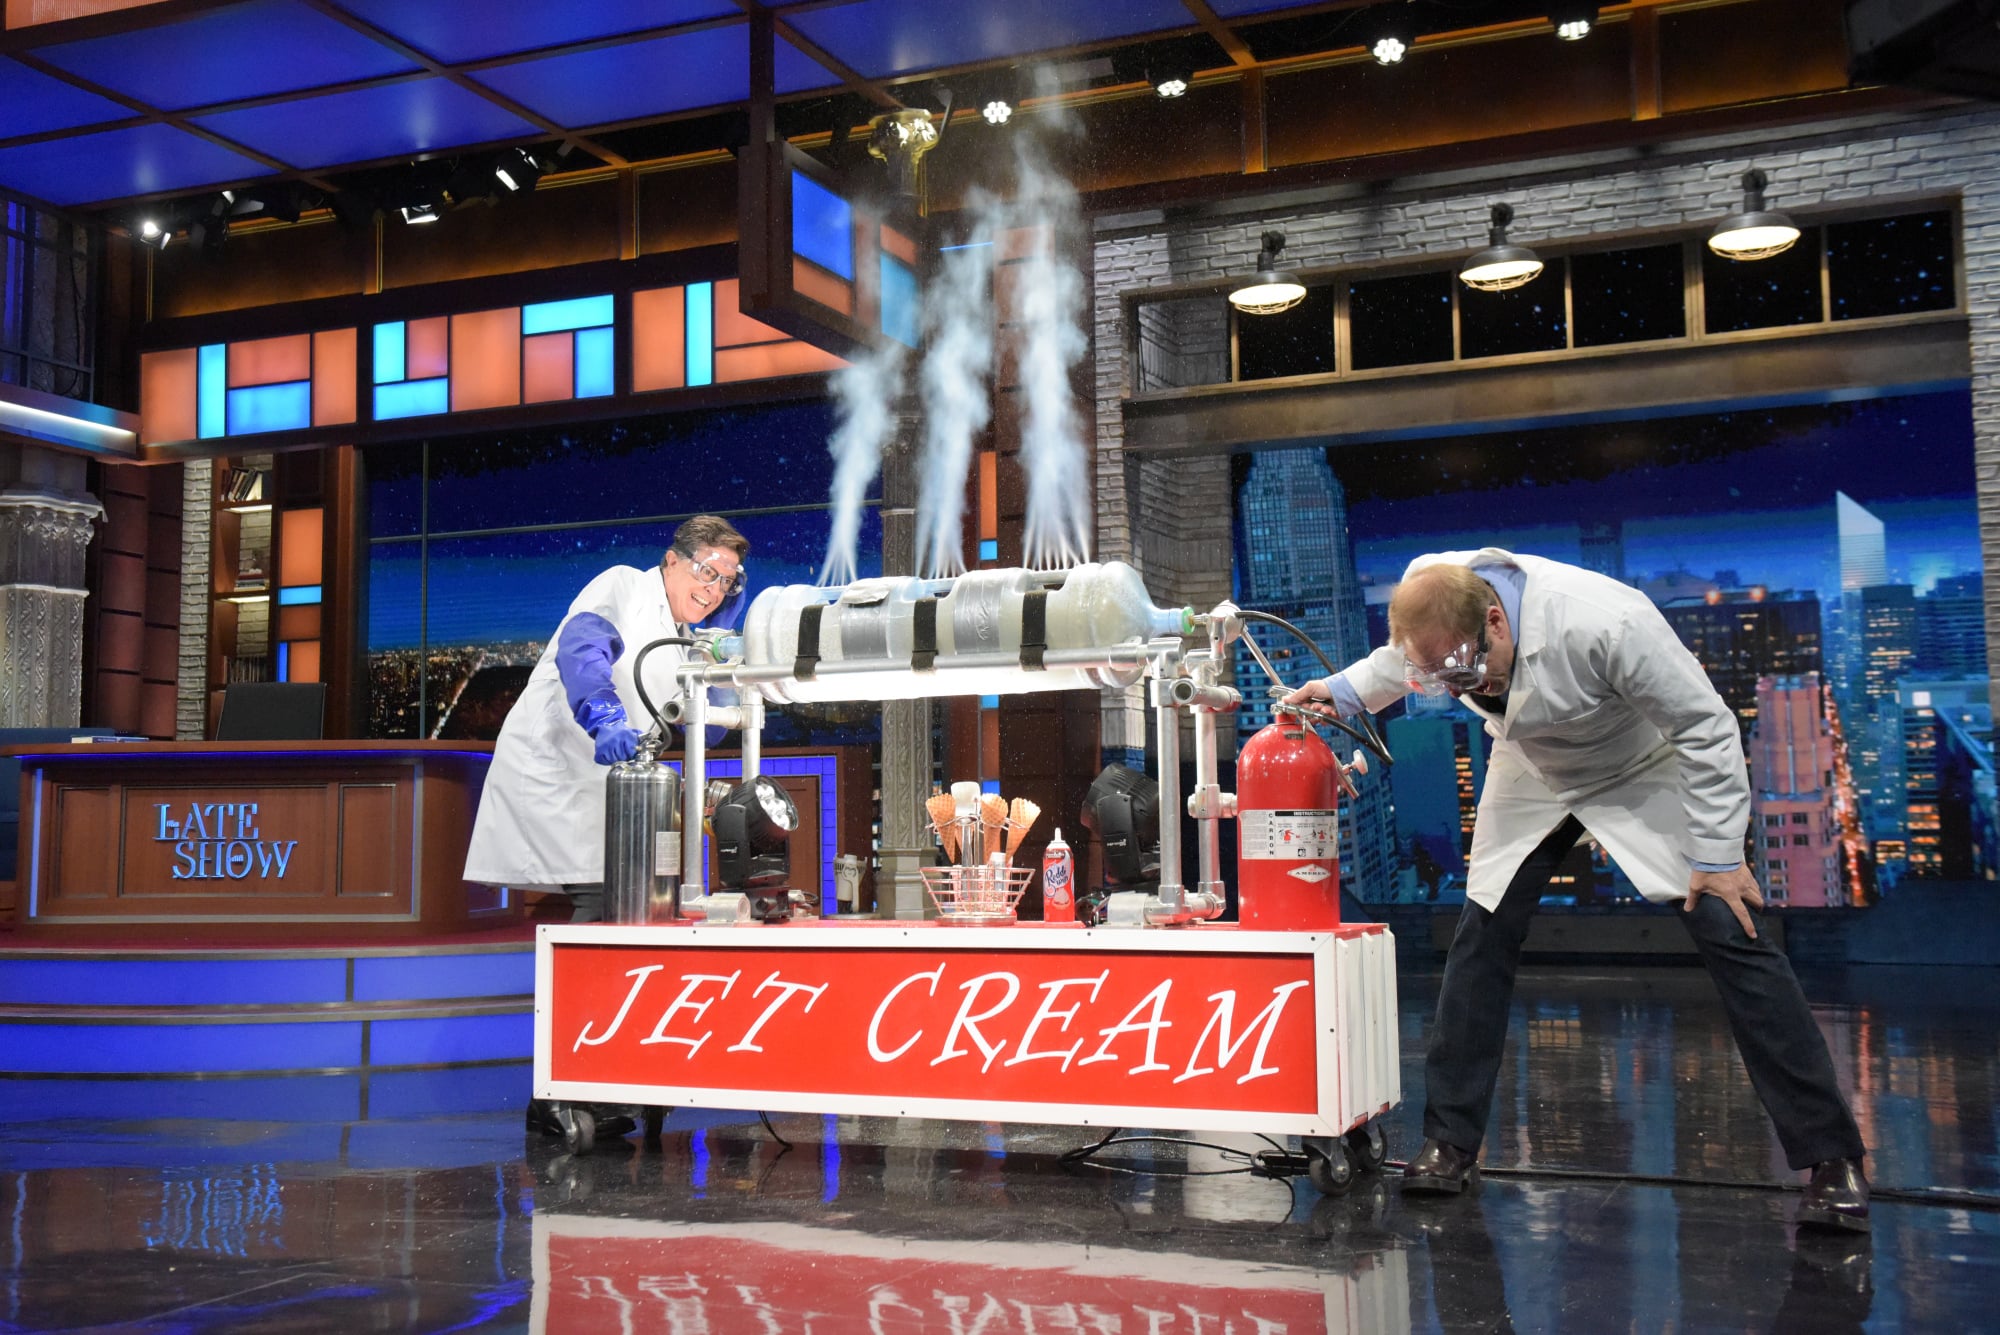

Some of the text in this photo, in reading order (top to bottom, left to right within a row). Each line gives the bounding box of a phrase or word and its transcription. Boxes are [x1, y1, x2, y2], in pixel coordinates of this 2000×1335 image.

[153, 803, 259, 840] LATE
[172, 840, 298, 879] SHOW
[573, 962, 1309, 1085] JET CREAM
